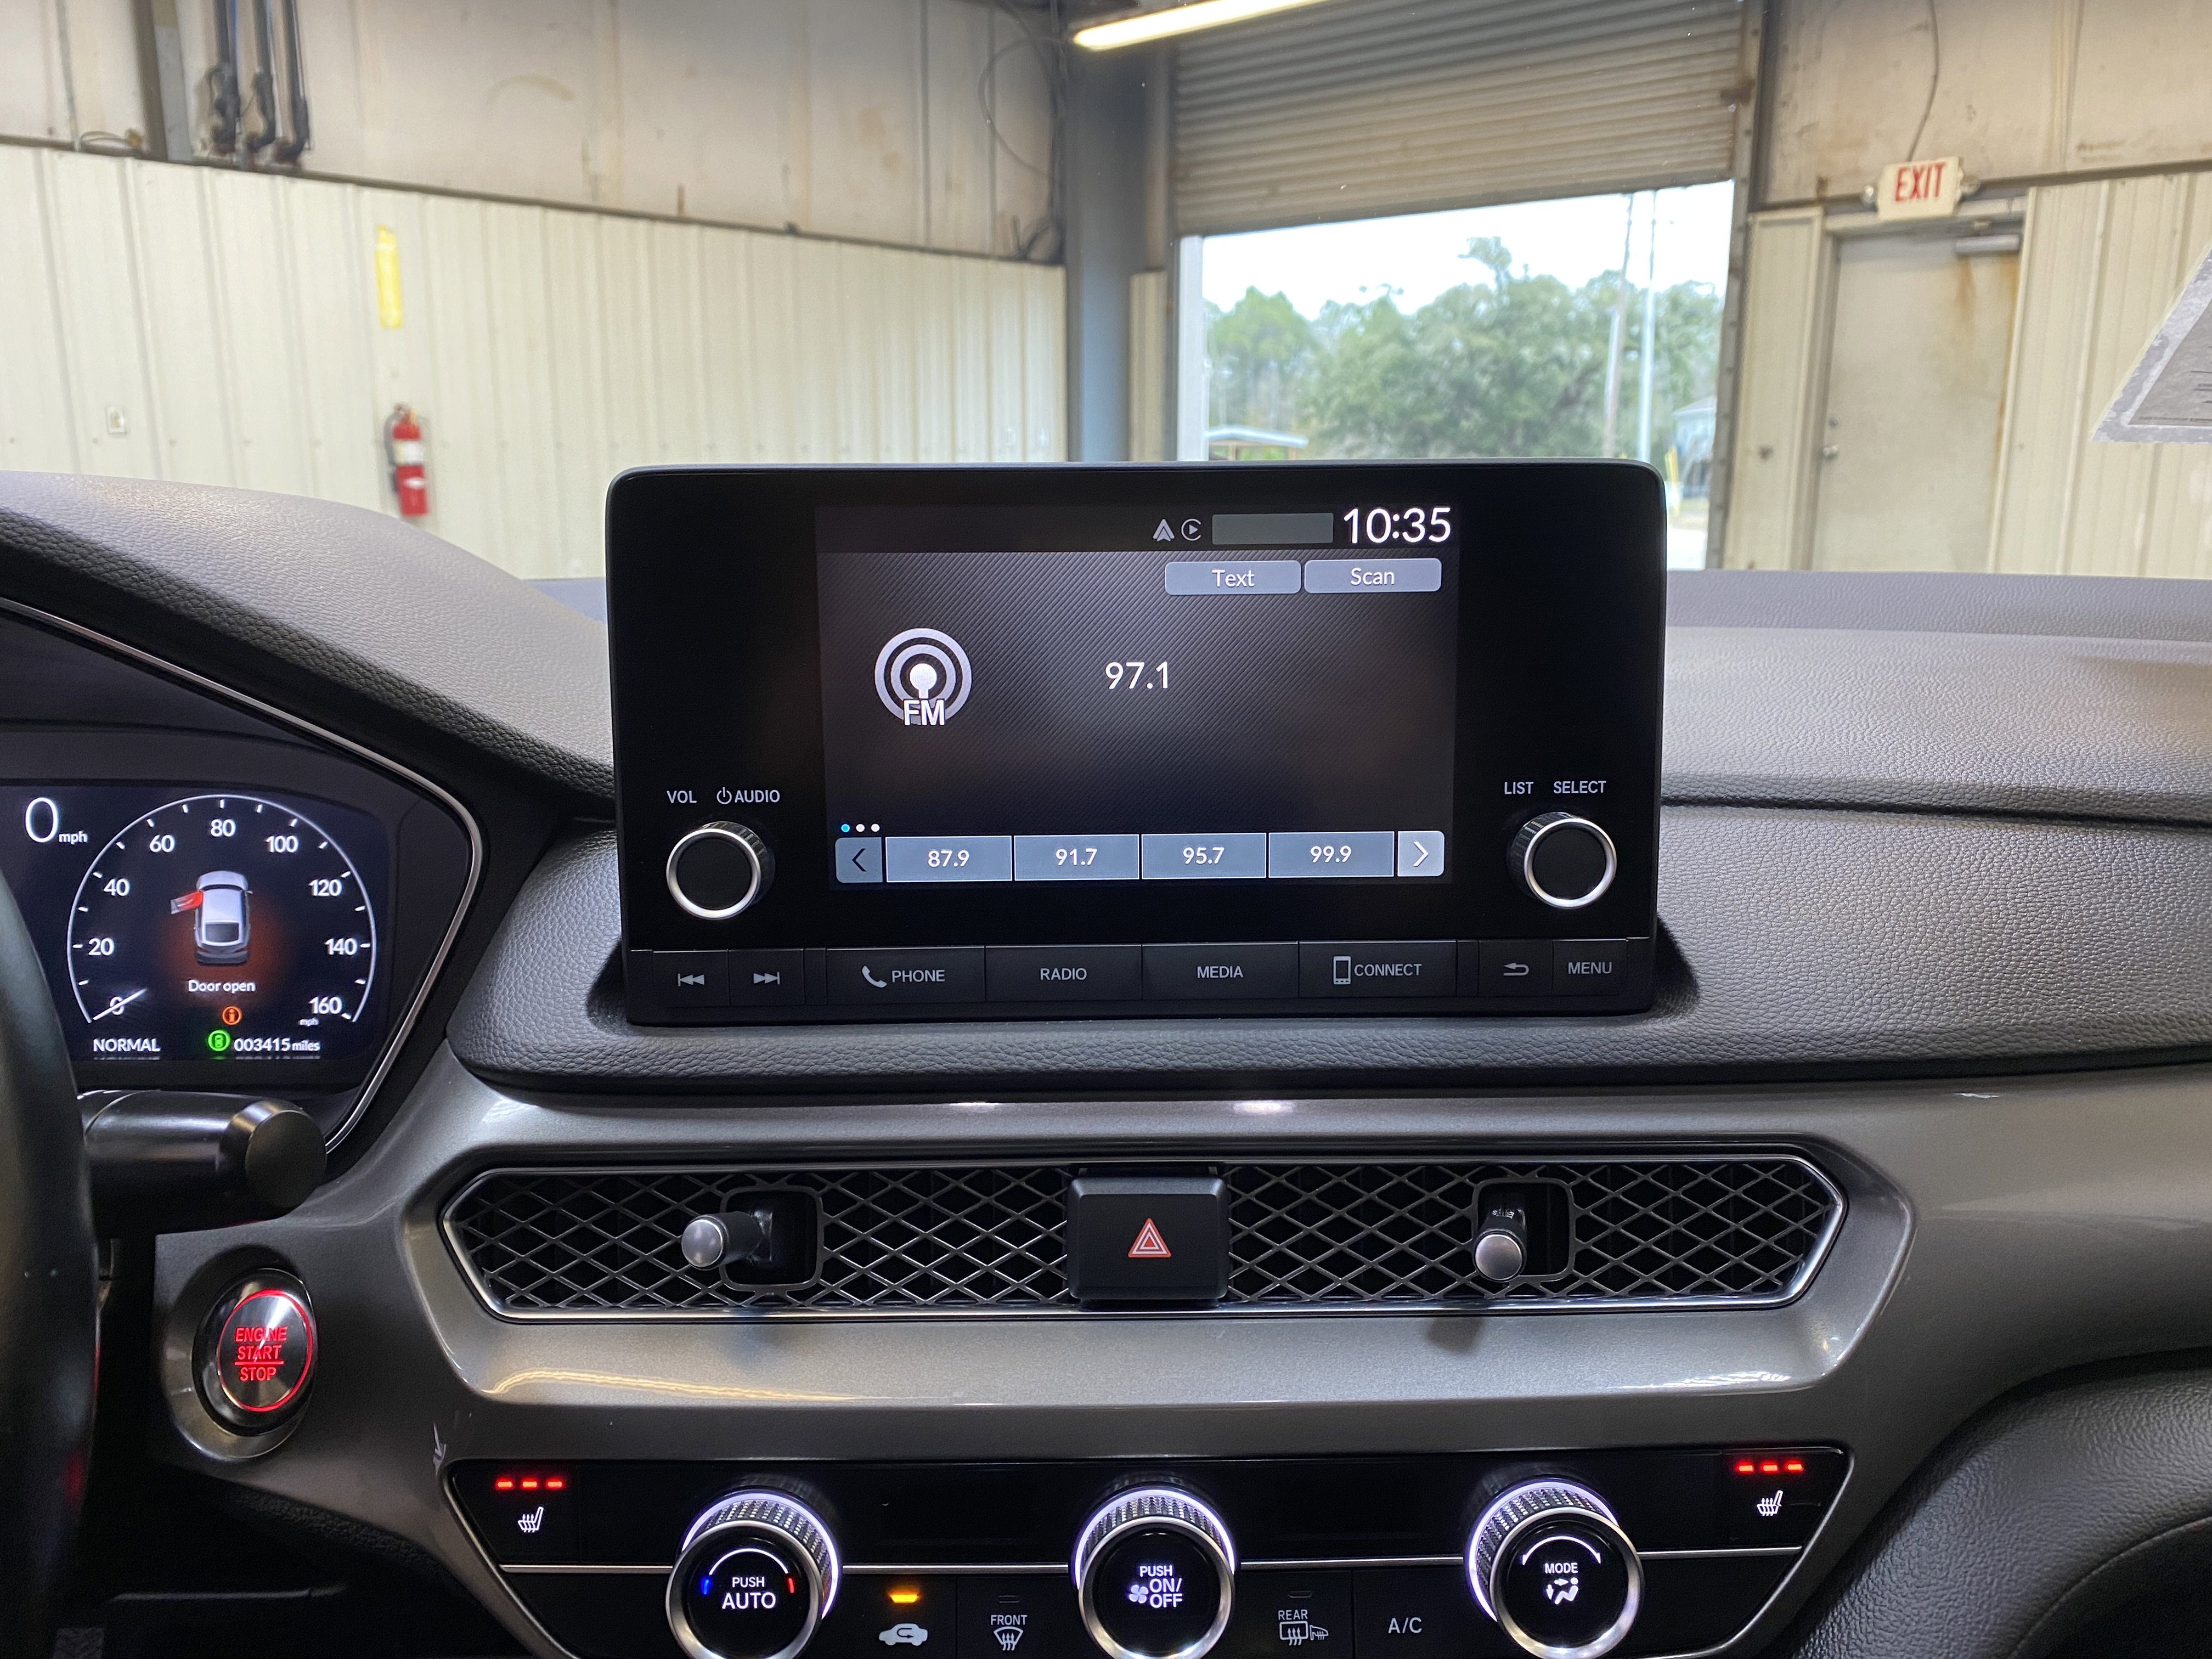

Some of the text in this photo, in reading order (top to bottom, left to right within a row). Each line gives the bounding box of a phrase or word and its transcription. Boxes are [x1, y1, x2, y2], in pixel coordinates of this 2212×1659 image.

[1895, 162, 1946, 202] EXIT
[1343, 506, 1452, 544] 10:35
[1211, 569, 1255, 588] Text
[1350, 567, 1395, 587] Scan
[1105, 661, 1170, 690] 97.1
[902, 699, 946, 726] FM
[1504, 781, 1534, 795] LIST
[1553, 780, 1607, 794] SELECT
[665, 789, 698, 804] VOL
[733, 789, 781, 804] AUDIO
[25, 797, 88, 844] 0 mph
[210, 819, 236, 837] 80
[149, 834, 176, 853] 60
[266, 835, 300, 853] 100
[927, 849, 970, 867] 87.9
[1055, 848, 1098, 866] 91.7
[1182, 847, 1225, 865] 95.7
[1310, 845, 1352, 863] 99.9
[103, 878, 131, 896] 40
[308, 878, 343, 896] 120
[88, 938, 115, 956] 20
[324, 938, 358, 956] 140
[891, 969, 946, 983] PHONE
[1040, 967, 1088, 981] RADIO
[1197, 965, 1244, 979] MEDIA
[1353, 963, 1423, 977] CONNECT
[1567, 961, 1612, 975] MENU
[188, 979, 256, 995] Door open
[308, 996, 343, 1014] 160
[298, 1017, 319, 1027] mph
[93, 1038, 161, 1052] NORMAL
[233, 1037, 321, 1052] 003415 miles
[238, 1345, 282, 1360] START
[240, 1367, 276, 1381] STOP
[1139, 1565, 1173, 1577] PUSH
[1543, 1561, 1578, 1575] MODE
[731, 1576, 766, 1589] PUSH
[1149, 1577, 1182, 1593] ON/
[721, 1591, 777, 1610] AUTO
[1150, 1593, 1183, 1609] OFF
[990, 1614, 1028, 1626] FRONT
[1277, 1609, 1308, 1621] REAR
[1387, 1616, 1423, 1634] A/C
